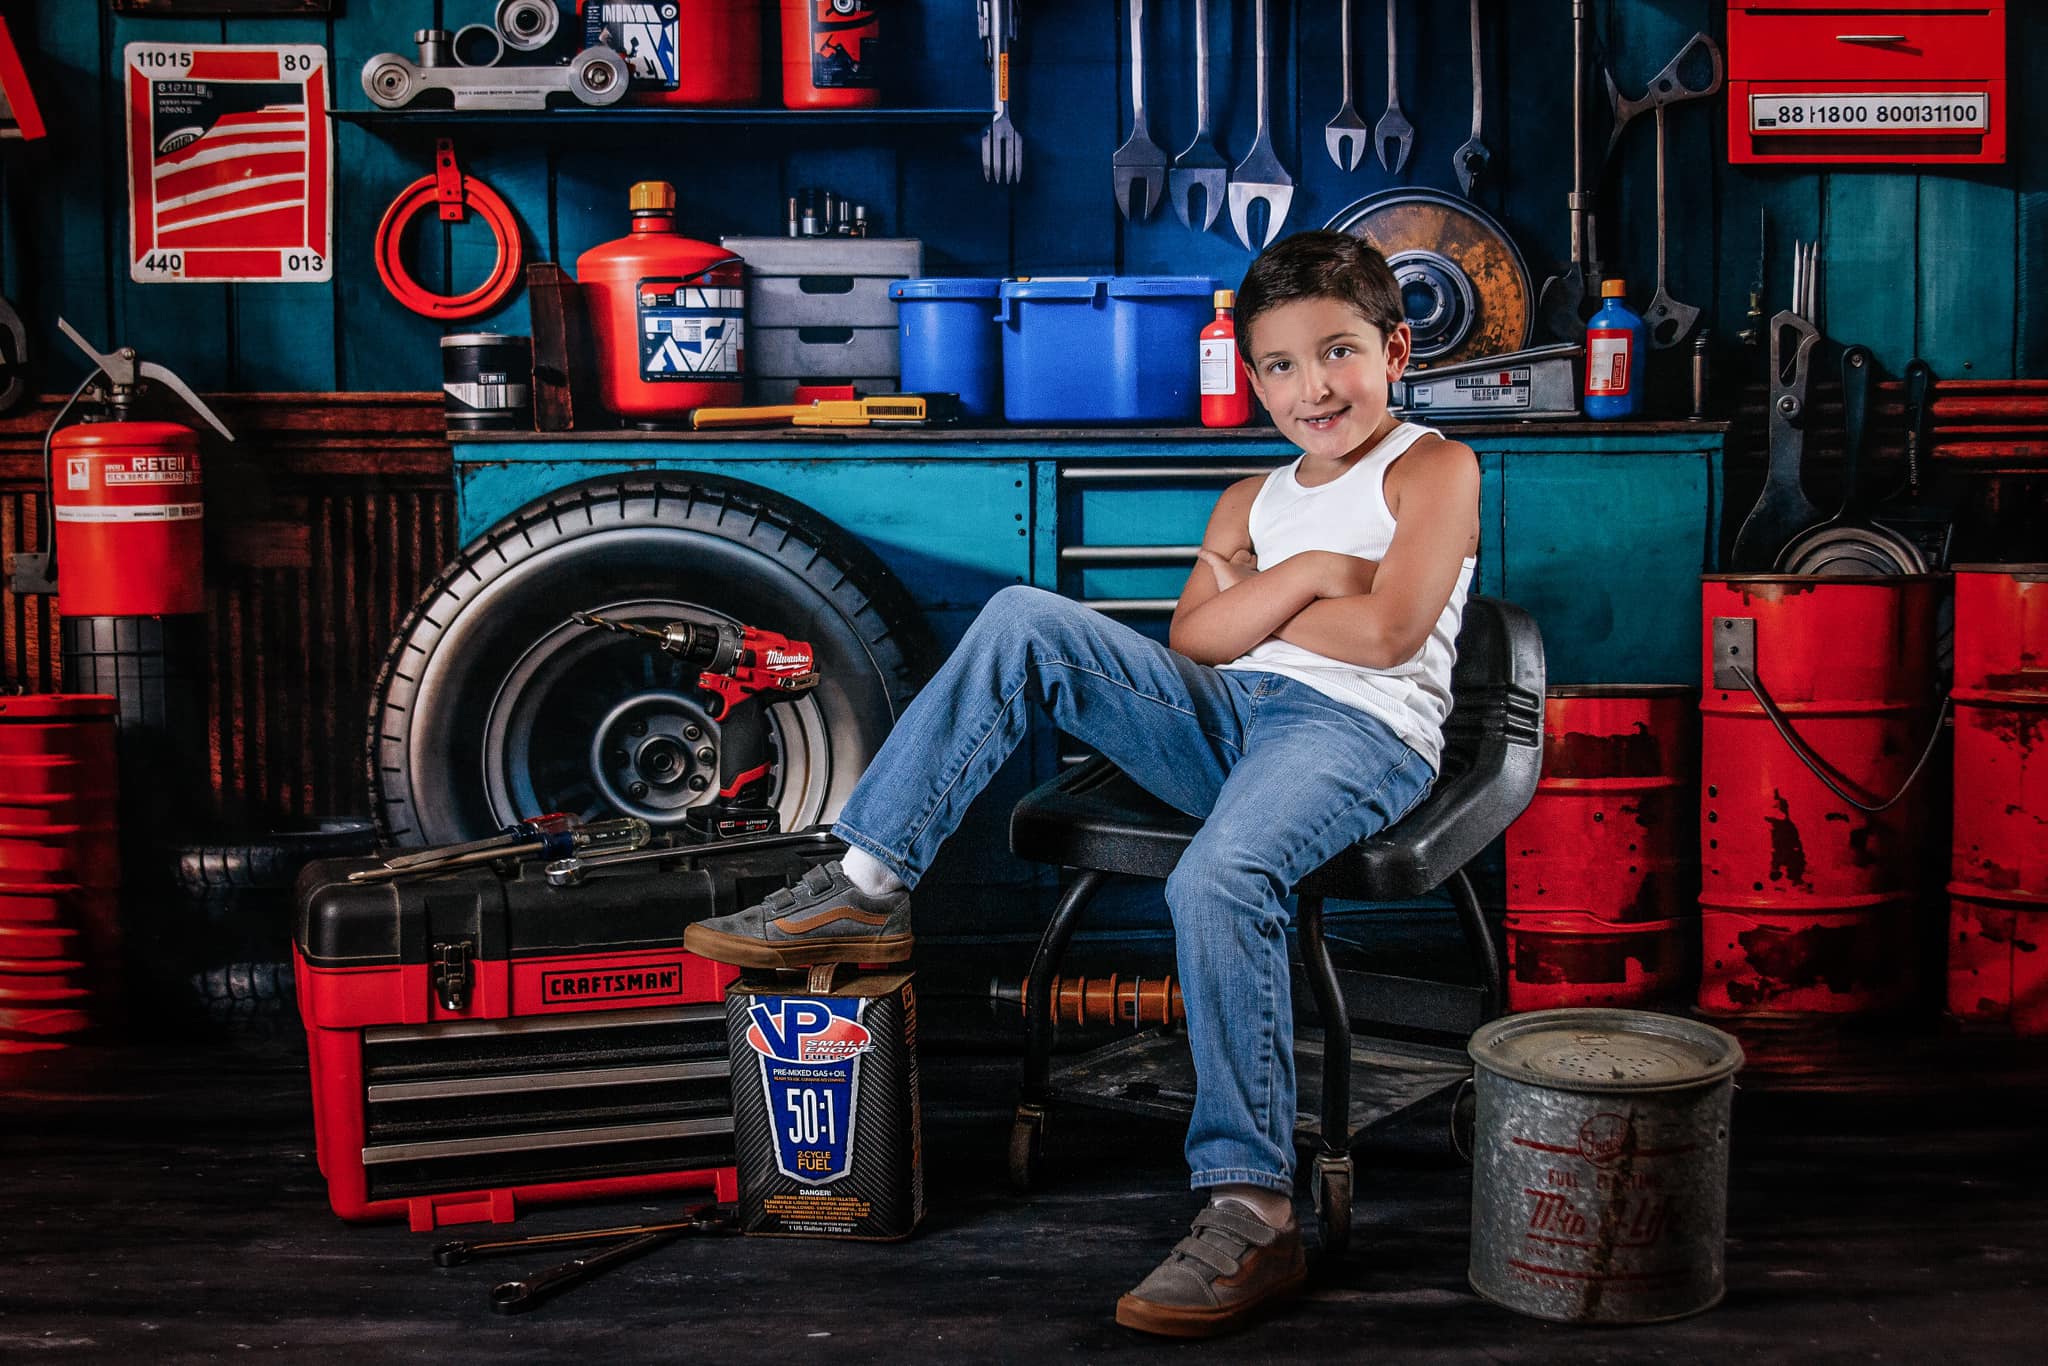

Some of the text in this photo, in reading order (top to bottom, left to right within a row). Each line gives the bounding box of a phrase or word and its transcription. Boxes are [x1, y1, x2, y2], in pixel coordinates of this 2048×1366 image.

[137, 52, 311, 71] 11015 80
[1778, 105, 1804, 123] 88
[145, 254, 182, 273] 440
[288, 254, 324, 272] 013
[766, 650, 810, 665] Milwaukee
[551, 971, 674, 995] CRAFTSMAN
[747, 1000, 832, 1061] VP
[805, 1039, 866, 1047] SMALL
[805, 1045, 877, 1053] ENGINE
[773, 1068, 812, 1077] PRE-MIXED
[787, 1088, 835, 1144] 50:1
[797, 1151, 832, 1159] 2-CYCLE
[797, 1159, 832, 1171] FUEL
[799, 1189, 832, 1197] DANGER!
